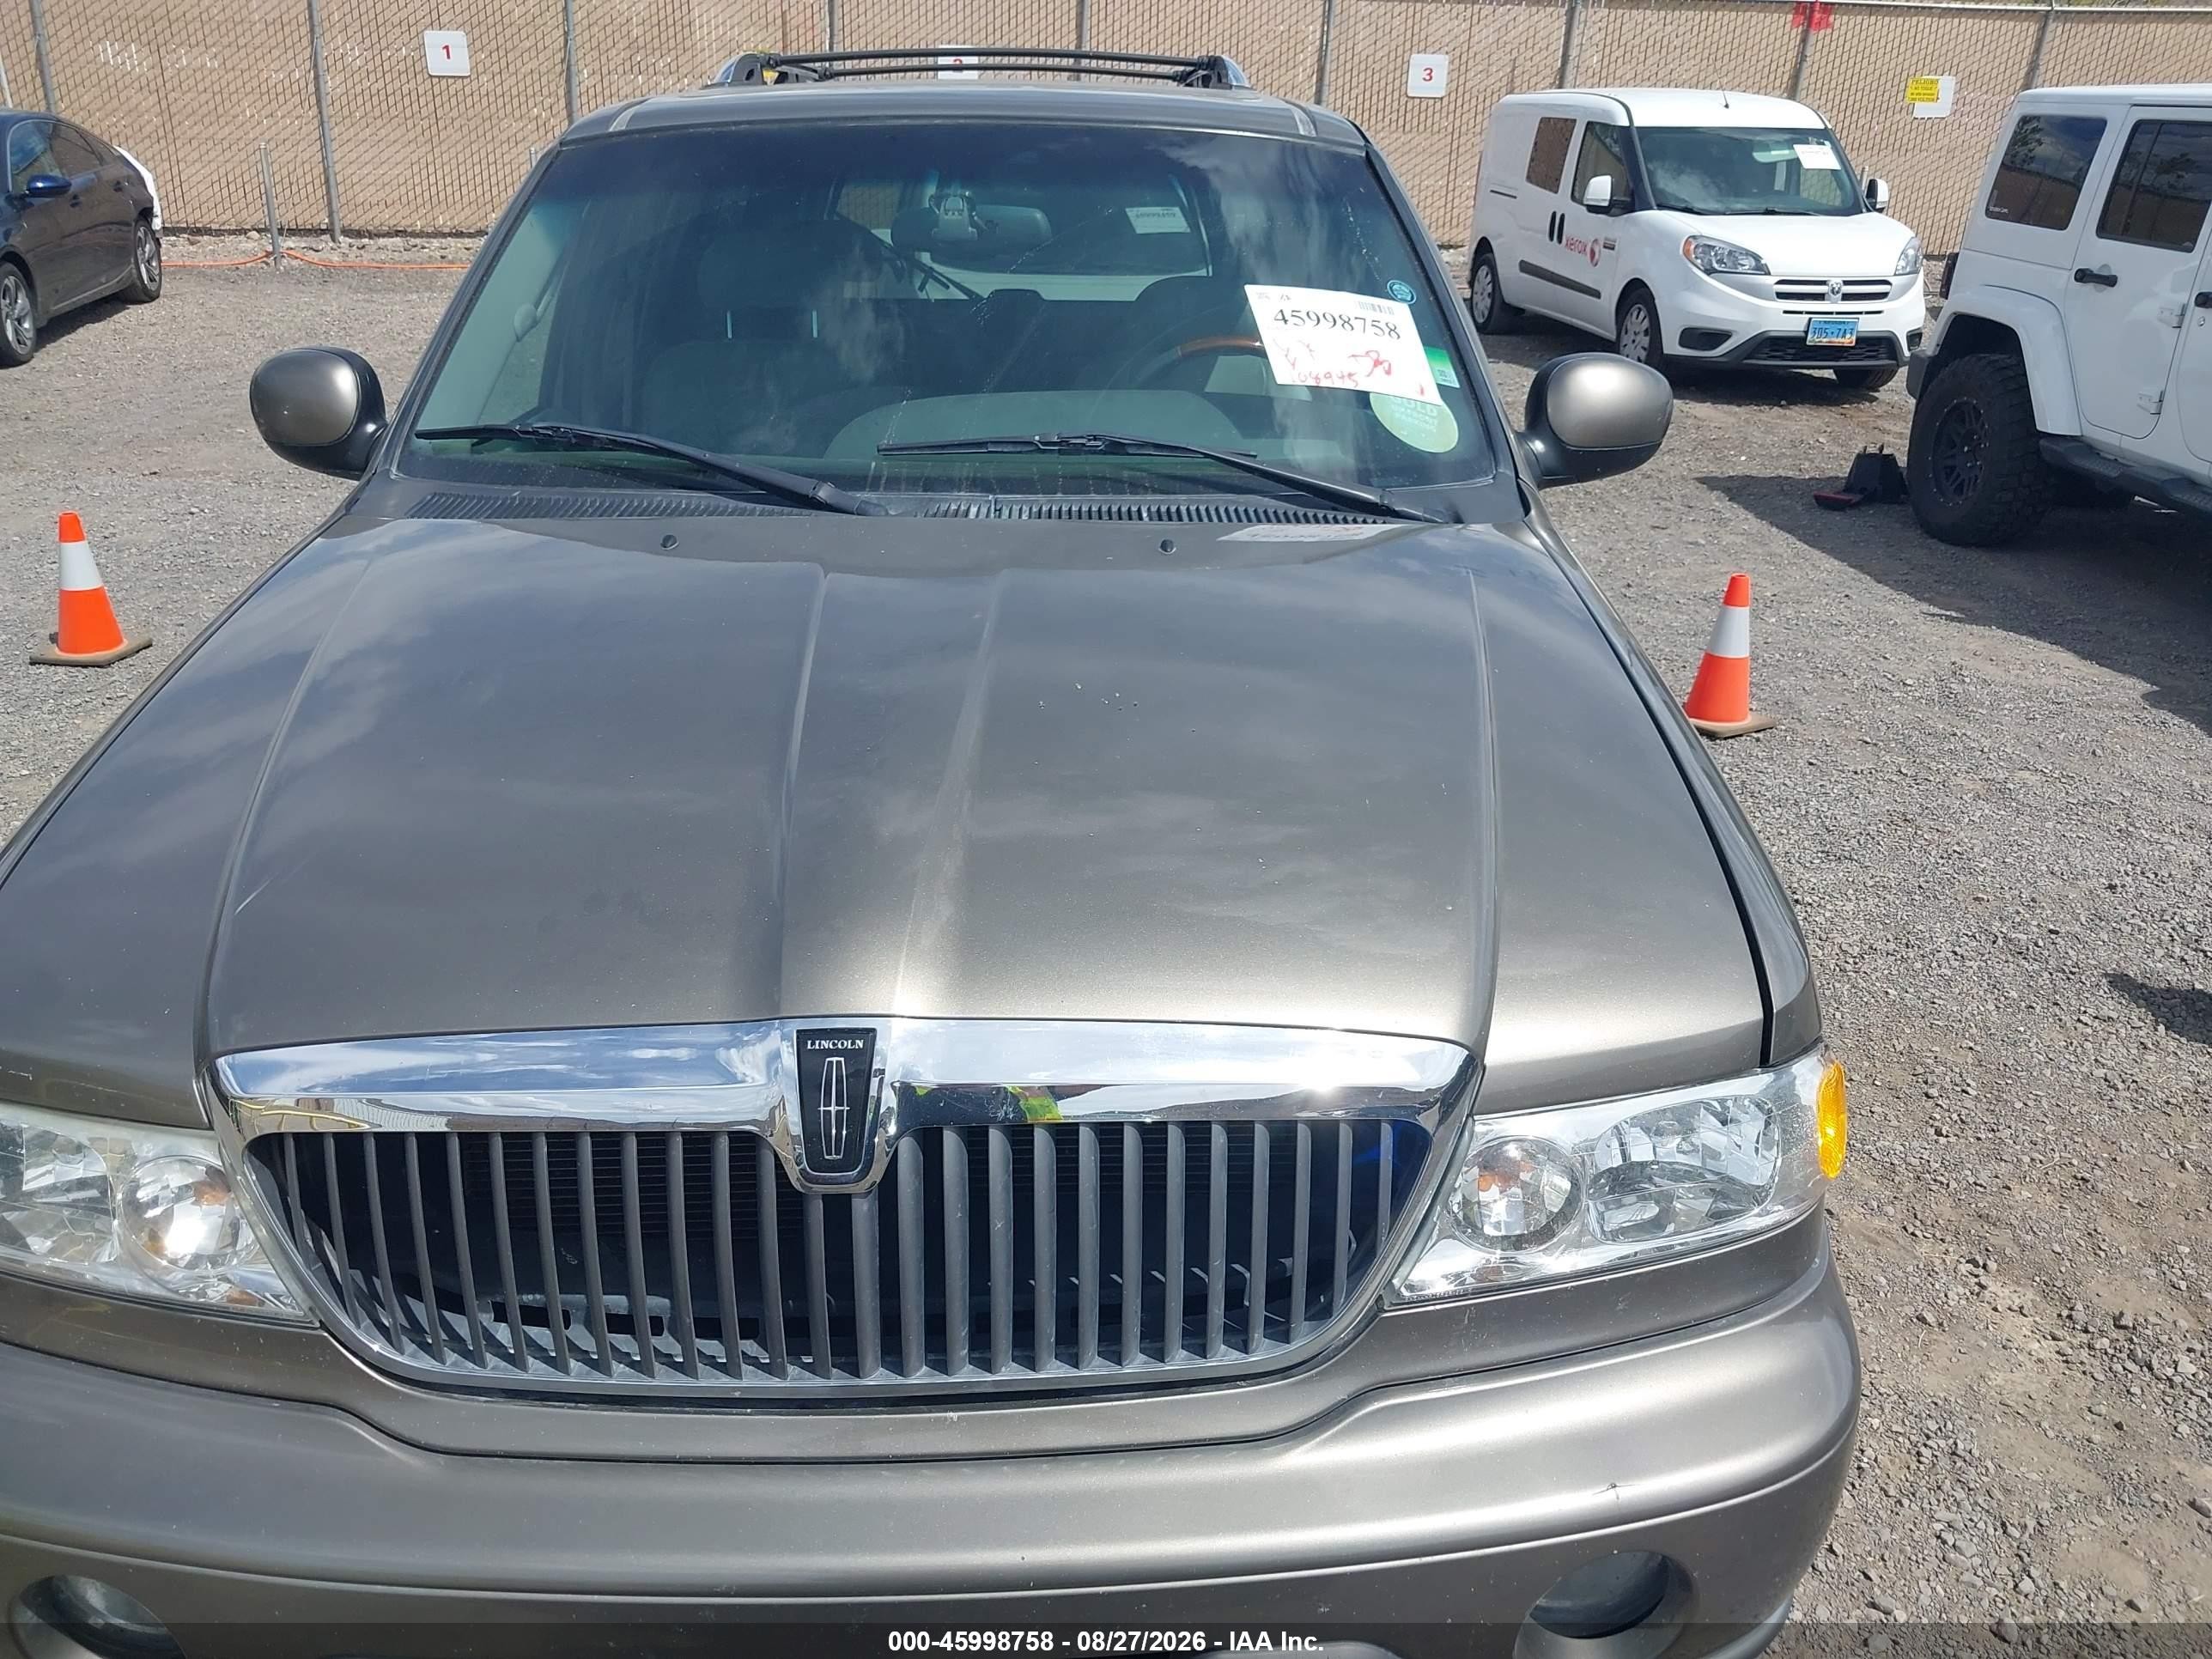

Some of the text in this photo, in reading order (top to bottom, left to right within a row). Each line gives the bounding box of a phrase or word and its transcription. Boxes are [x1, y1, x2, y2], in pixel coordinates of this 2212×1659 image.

[441, 45, 451, 60] 1
[1422, 67, 1434, 82] 3
[1565, 237, 1588, 256] xerox
[1273, 308, 1401, 340] 45998758
[806, 1039, 864, 1049] LINCOLN
